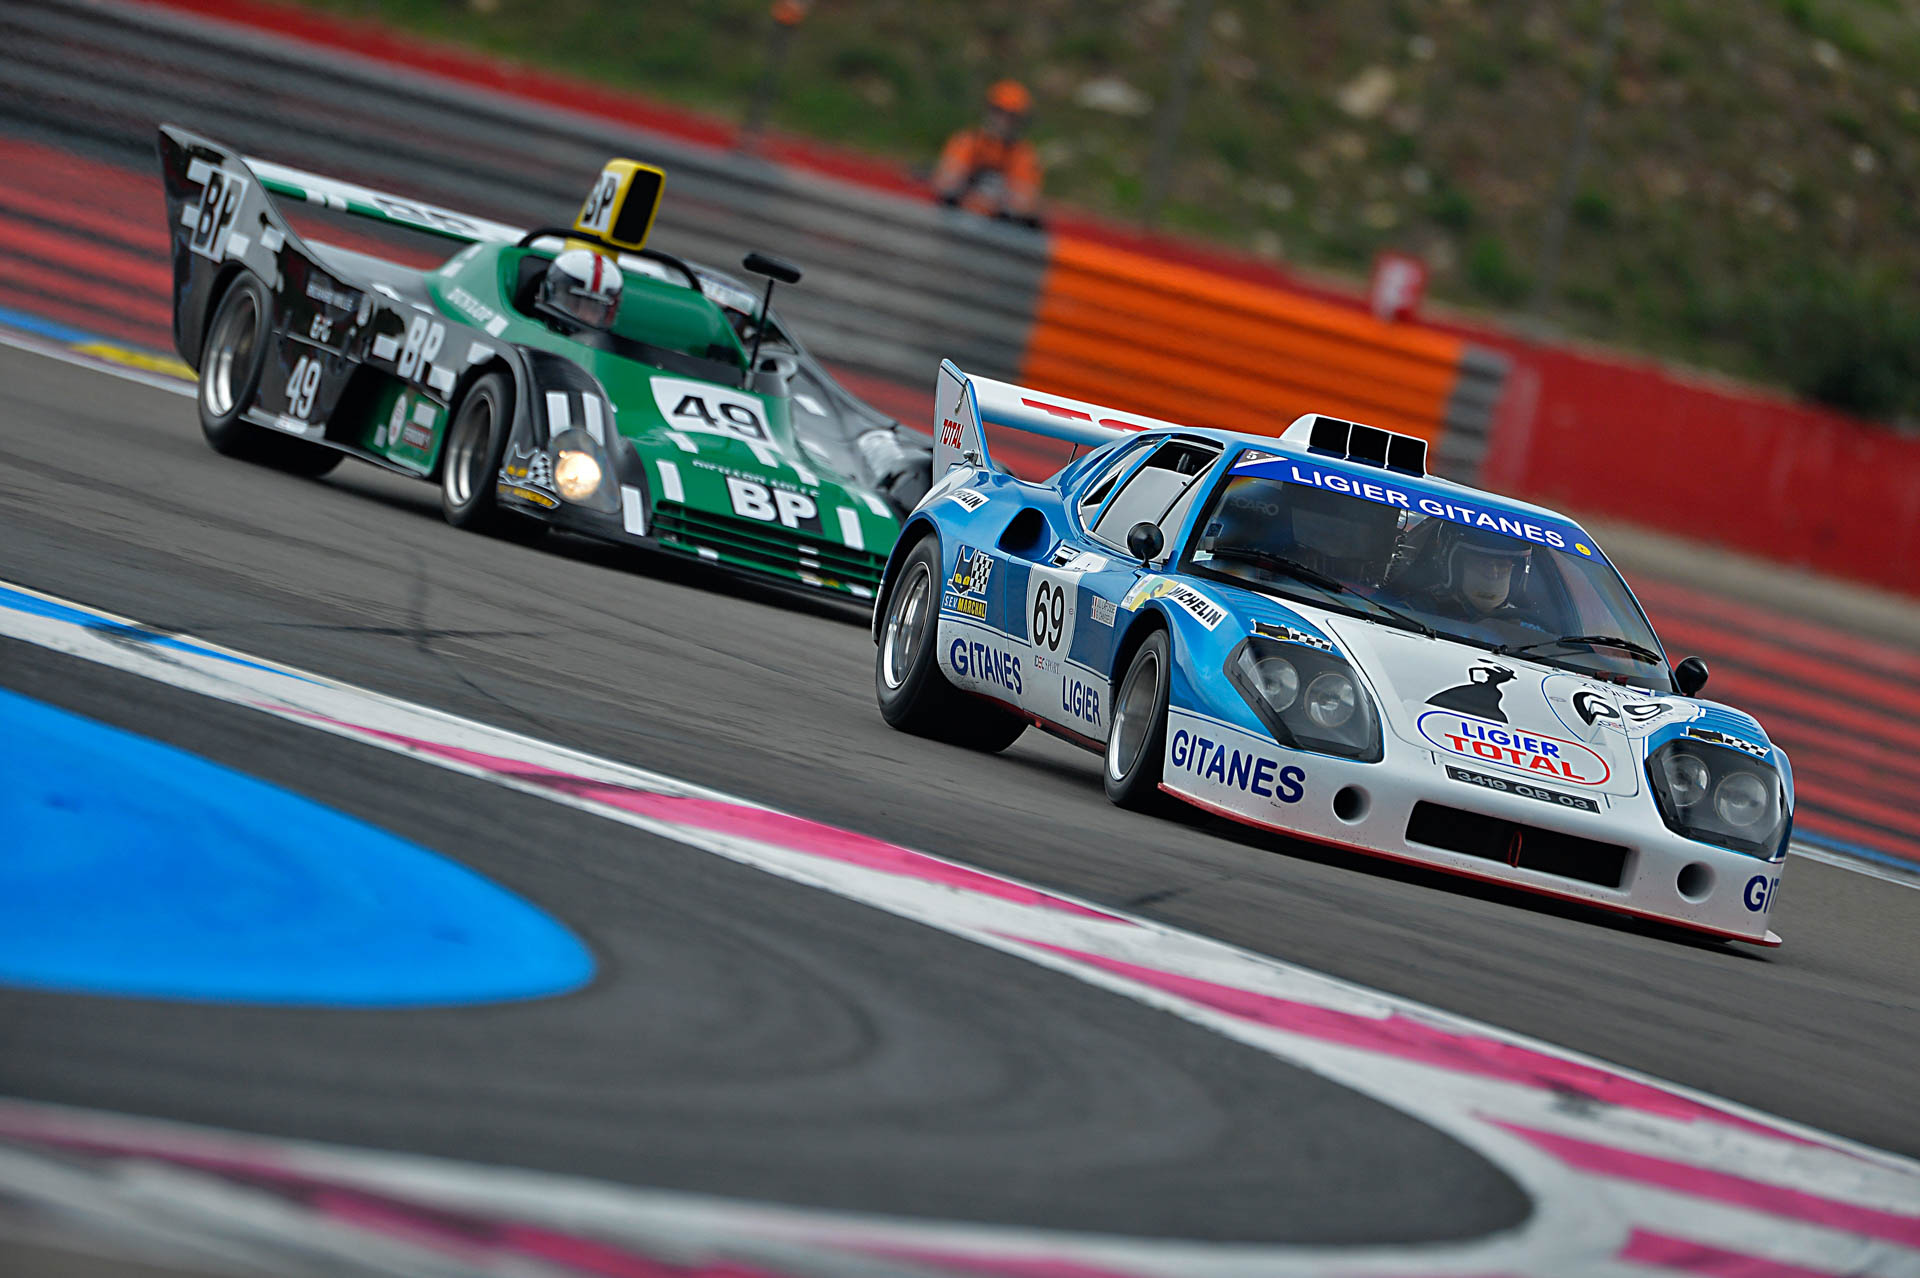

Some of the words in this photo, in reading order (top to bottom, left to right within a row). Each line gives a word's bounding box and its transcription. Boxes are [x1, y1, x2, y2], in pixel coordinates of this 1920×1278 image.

[191, 167, 248, 262] BP
[397, 316, 446, 383] BP
[286, 355, 322, 419] 49
[673, 395, 768, 441] 49
[939, 419, 965, 450] TOTAL
[726, 477, 818, 529] BP
[1291, 466, 1410, 508] LIGIER
[1419, 499, 1565, 549] GITANES
[957, 595, 986, 618] MARCHAL
[1033, 580, 1064, 651] 69
[1168, 586, 1223, 626] MICHELIN
[950, 638, 1023, 695] GITANES
[1062, 675, 1101, 726] LIGIER
[1572, 691, 1673, 726] 69
[1171, 729, 1306, 803] GITANES
[1445, 733, 1586, 781] TOTAL
[1461, 722, 1560, 759] LIGIER
[1457, 770, 1507, 790] 3419
[1515, 785, 1552, 802] QB
[1559, 795, 1590, 810] 03
